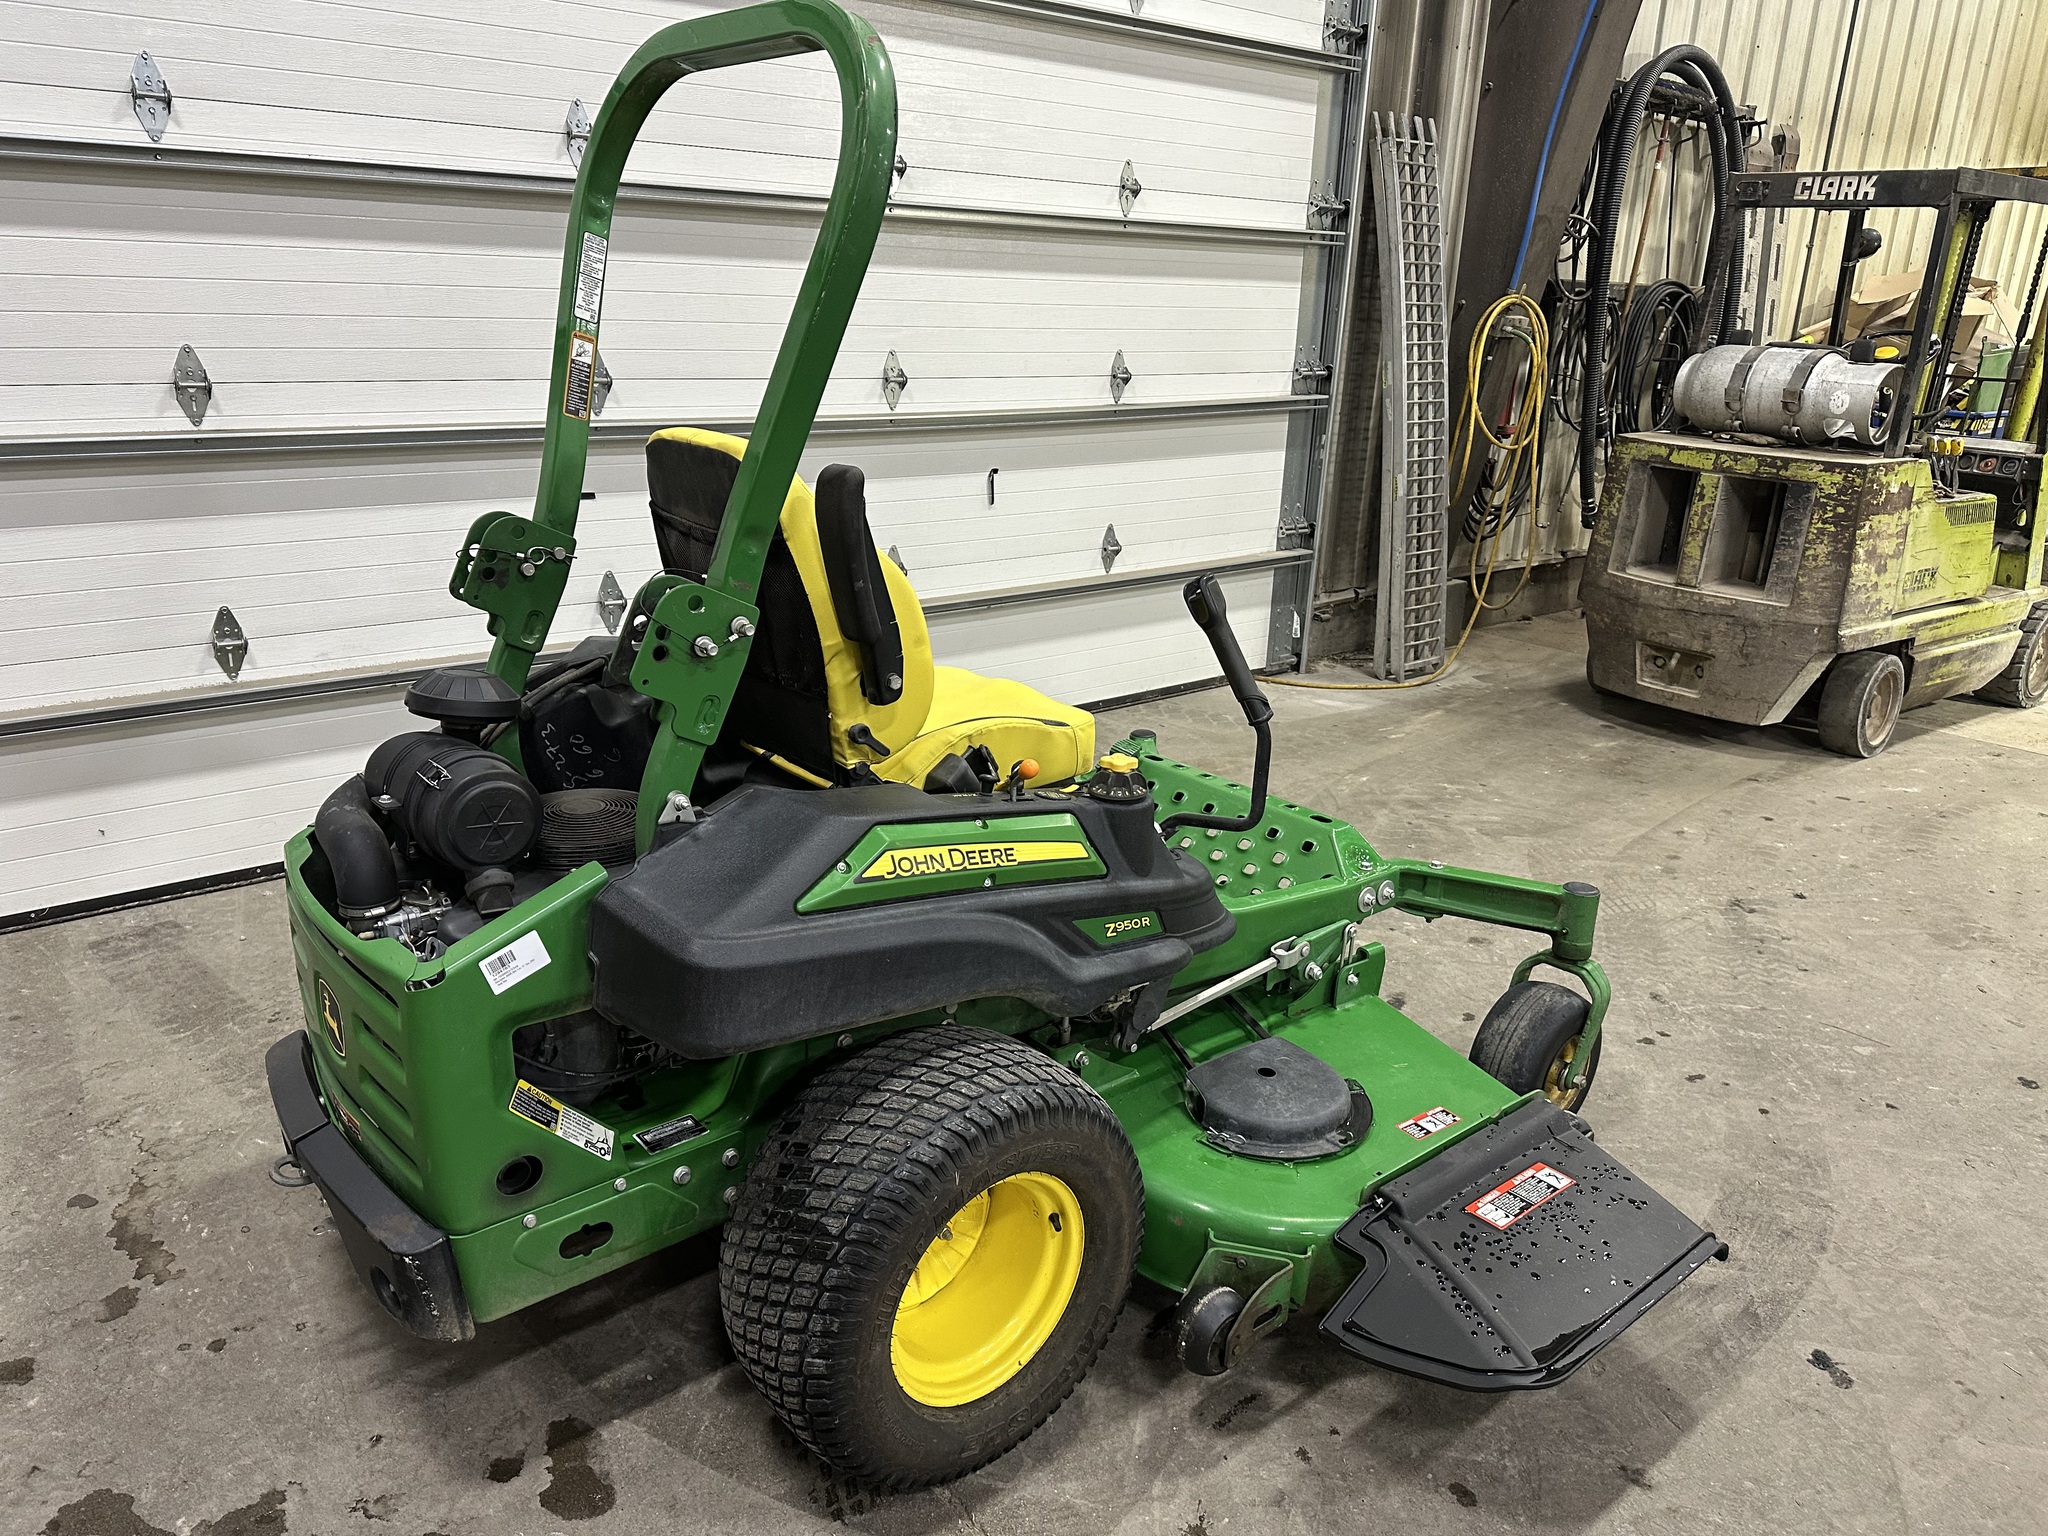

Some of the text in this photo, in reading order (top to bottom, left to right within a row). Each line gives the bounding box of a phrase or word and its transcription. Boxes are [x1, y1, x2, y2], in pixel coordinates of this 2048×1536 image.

[1793, 174, 1879, 200] CLARK
[886, 848, 1017, 876] JOHN DEERE
[1105, 916, 1151, 937] Z950R
[531, 1088, 552, 1105] CAUTION
[961, 1302, 1112, 1458] CARLISLE
